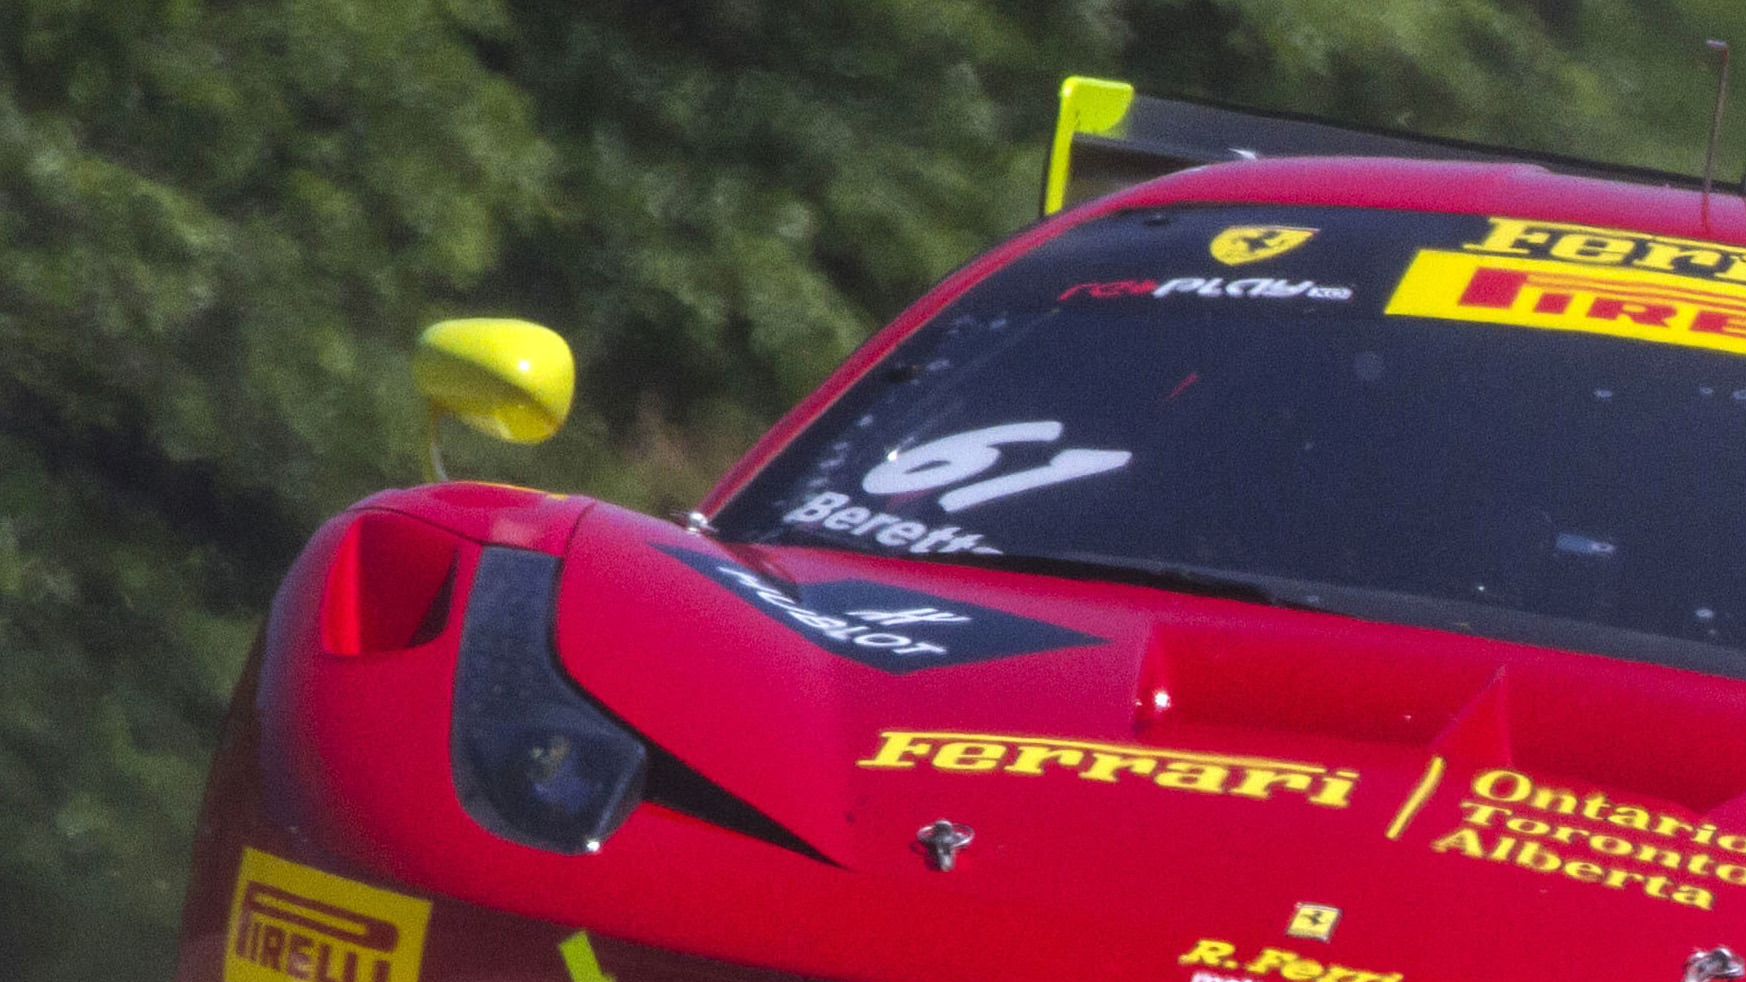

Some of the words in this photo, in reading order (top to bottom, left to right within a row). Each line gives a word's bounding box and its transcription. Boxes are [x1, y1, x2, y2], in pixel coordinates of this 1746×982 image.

[863, 420, 1133, 513] 61
[782, 490, 1004, 554] Berett
[716, 565, 949, 655] HUBLOT
[856, 730, 1361, 808] Ferrari
[1431, 827, 1716, 912] Alberta
[1176, 938, 1239, 971] R.
